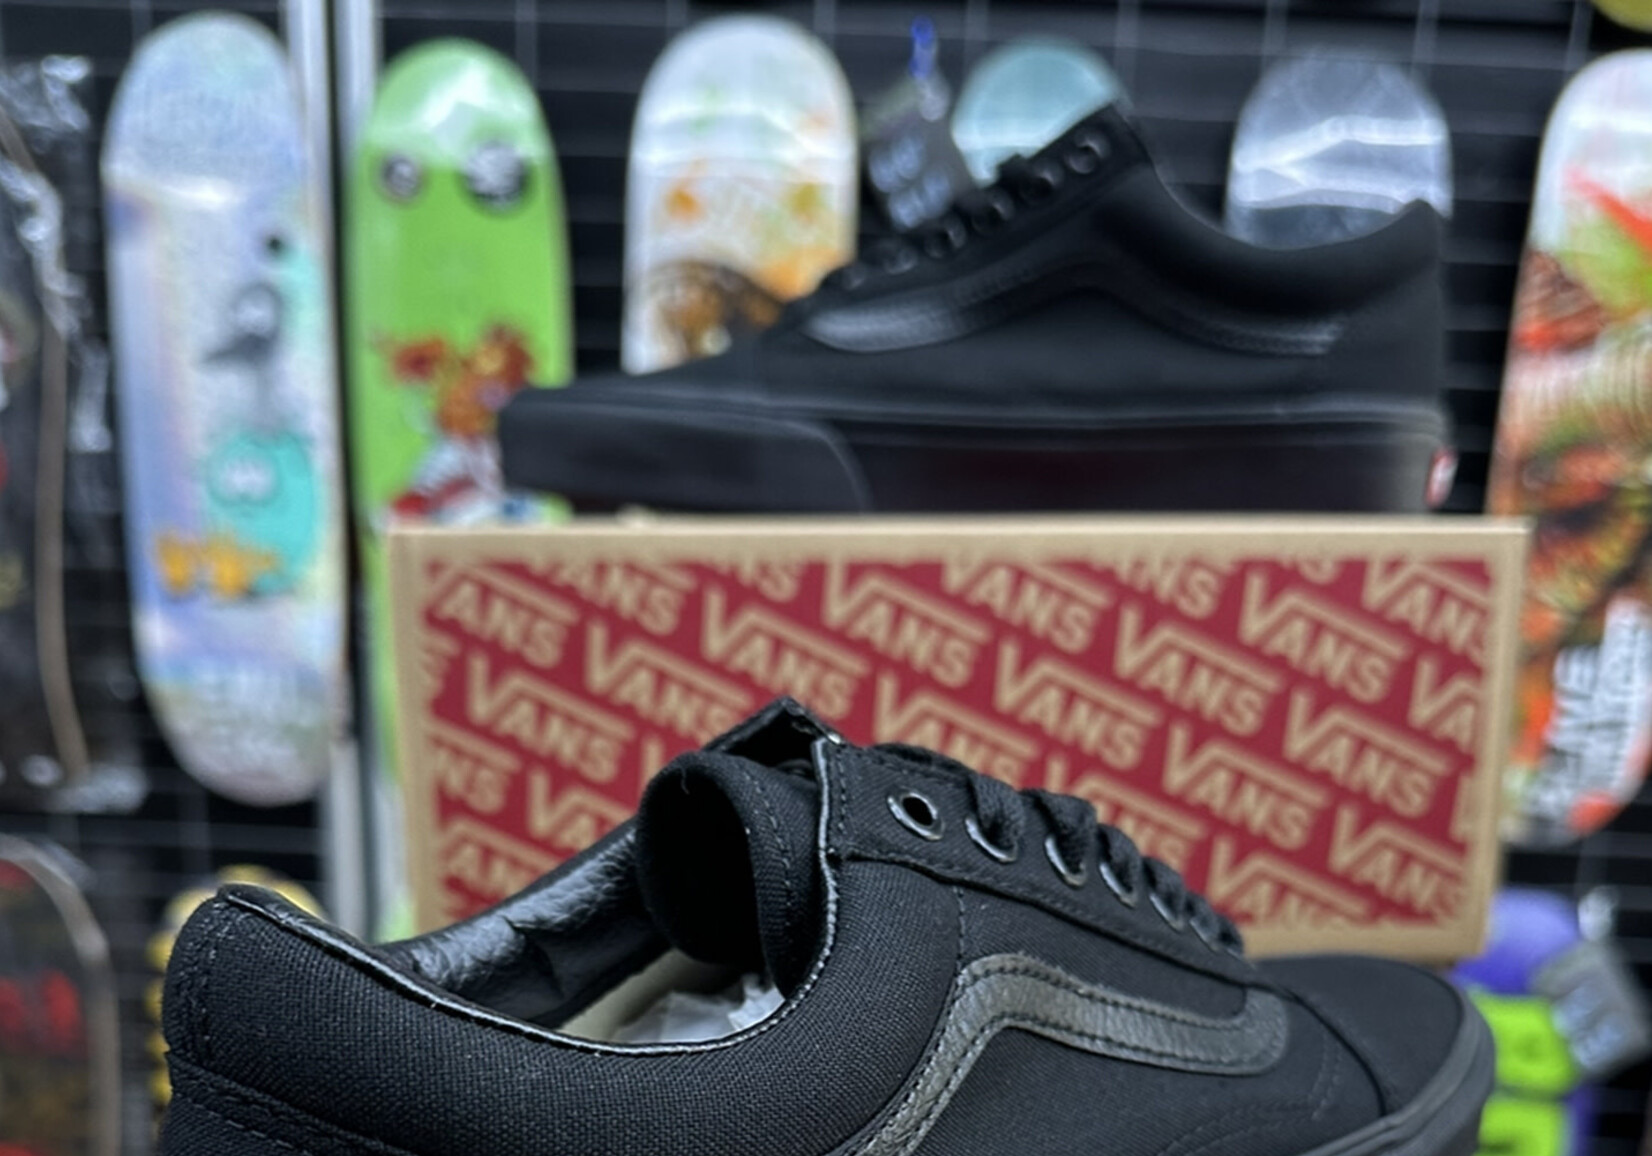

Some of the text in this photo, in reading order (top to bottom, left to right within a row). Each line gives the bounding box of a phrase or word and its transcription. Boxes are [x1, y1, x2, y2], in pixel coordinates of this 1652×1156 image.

[702, 582, 870, 721] VANS
[822, 560, 990, 688] VANS
[1113, 600, 1286, 736] VANS
[1238, 570, 1412, 703] VANS
[466, 650, 637, 784] VANS
[992, 637, 1163, 769] VANS
[1284, 688, 1450, 818] VANS
[1163, 721, 1329, 850] VANS
